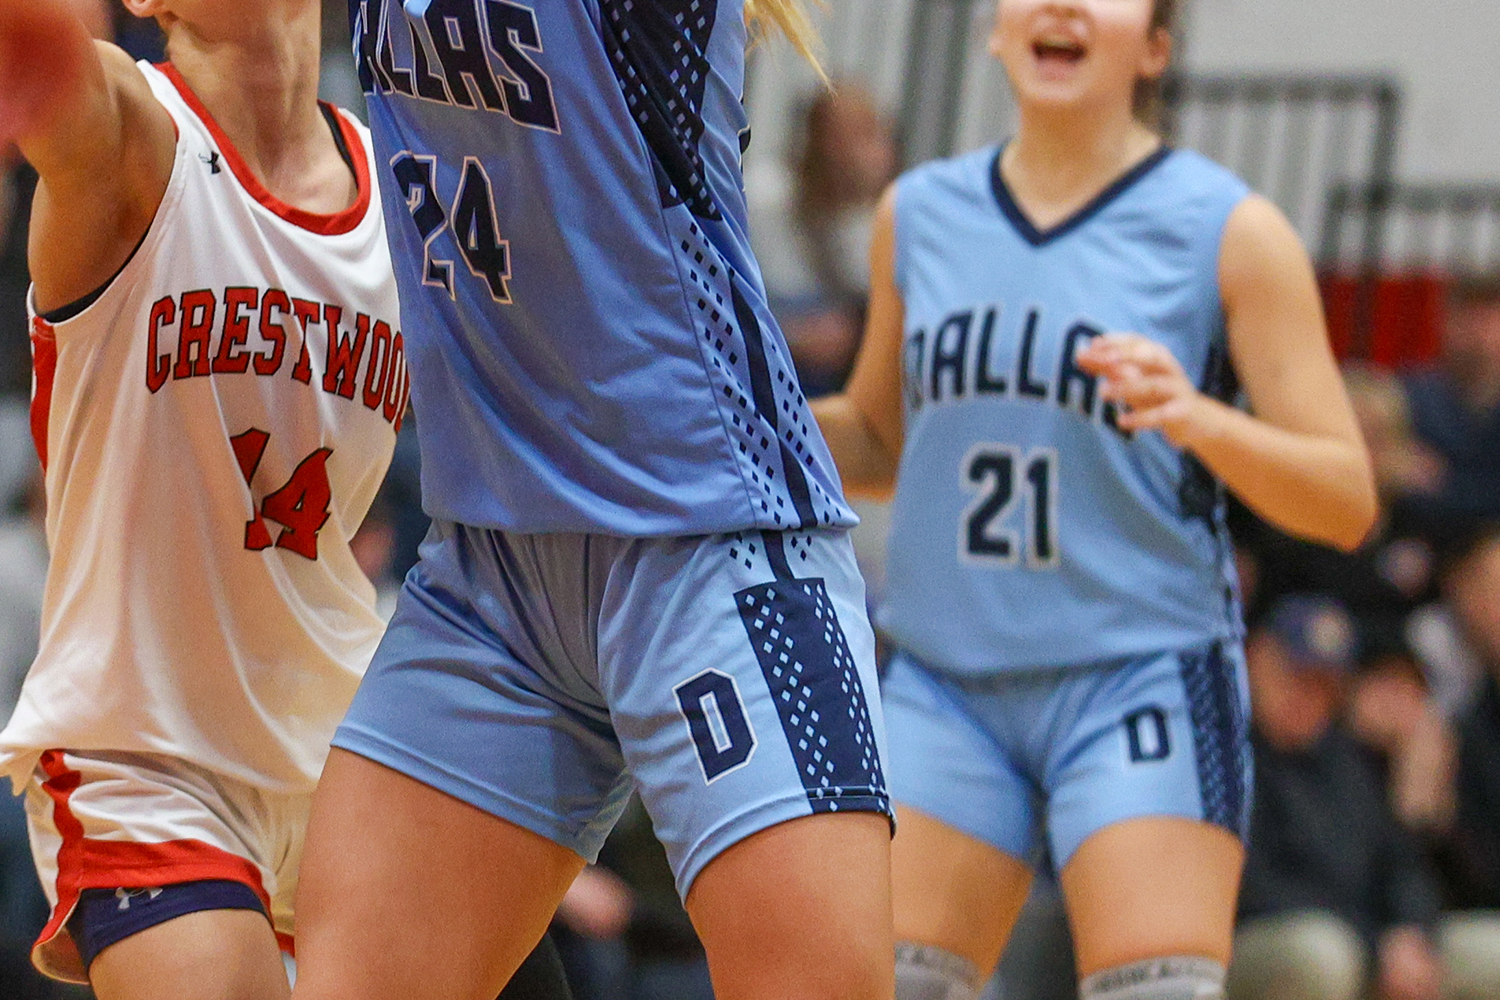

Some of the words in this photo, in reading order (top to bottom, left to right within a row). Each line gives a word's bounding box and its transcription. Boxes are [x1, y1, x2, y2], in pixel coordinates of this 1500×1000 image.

[389, 149, 513, 305] 24
[145, 285, 411, 434] CRESTWOO
[229, 426, 334, 561] 14
[959, 443, 1060, 568] 21
[671, 666, 758, 786] D
[1123, 703, 1172, 765] D
